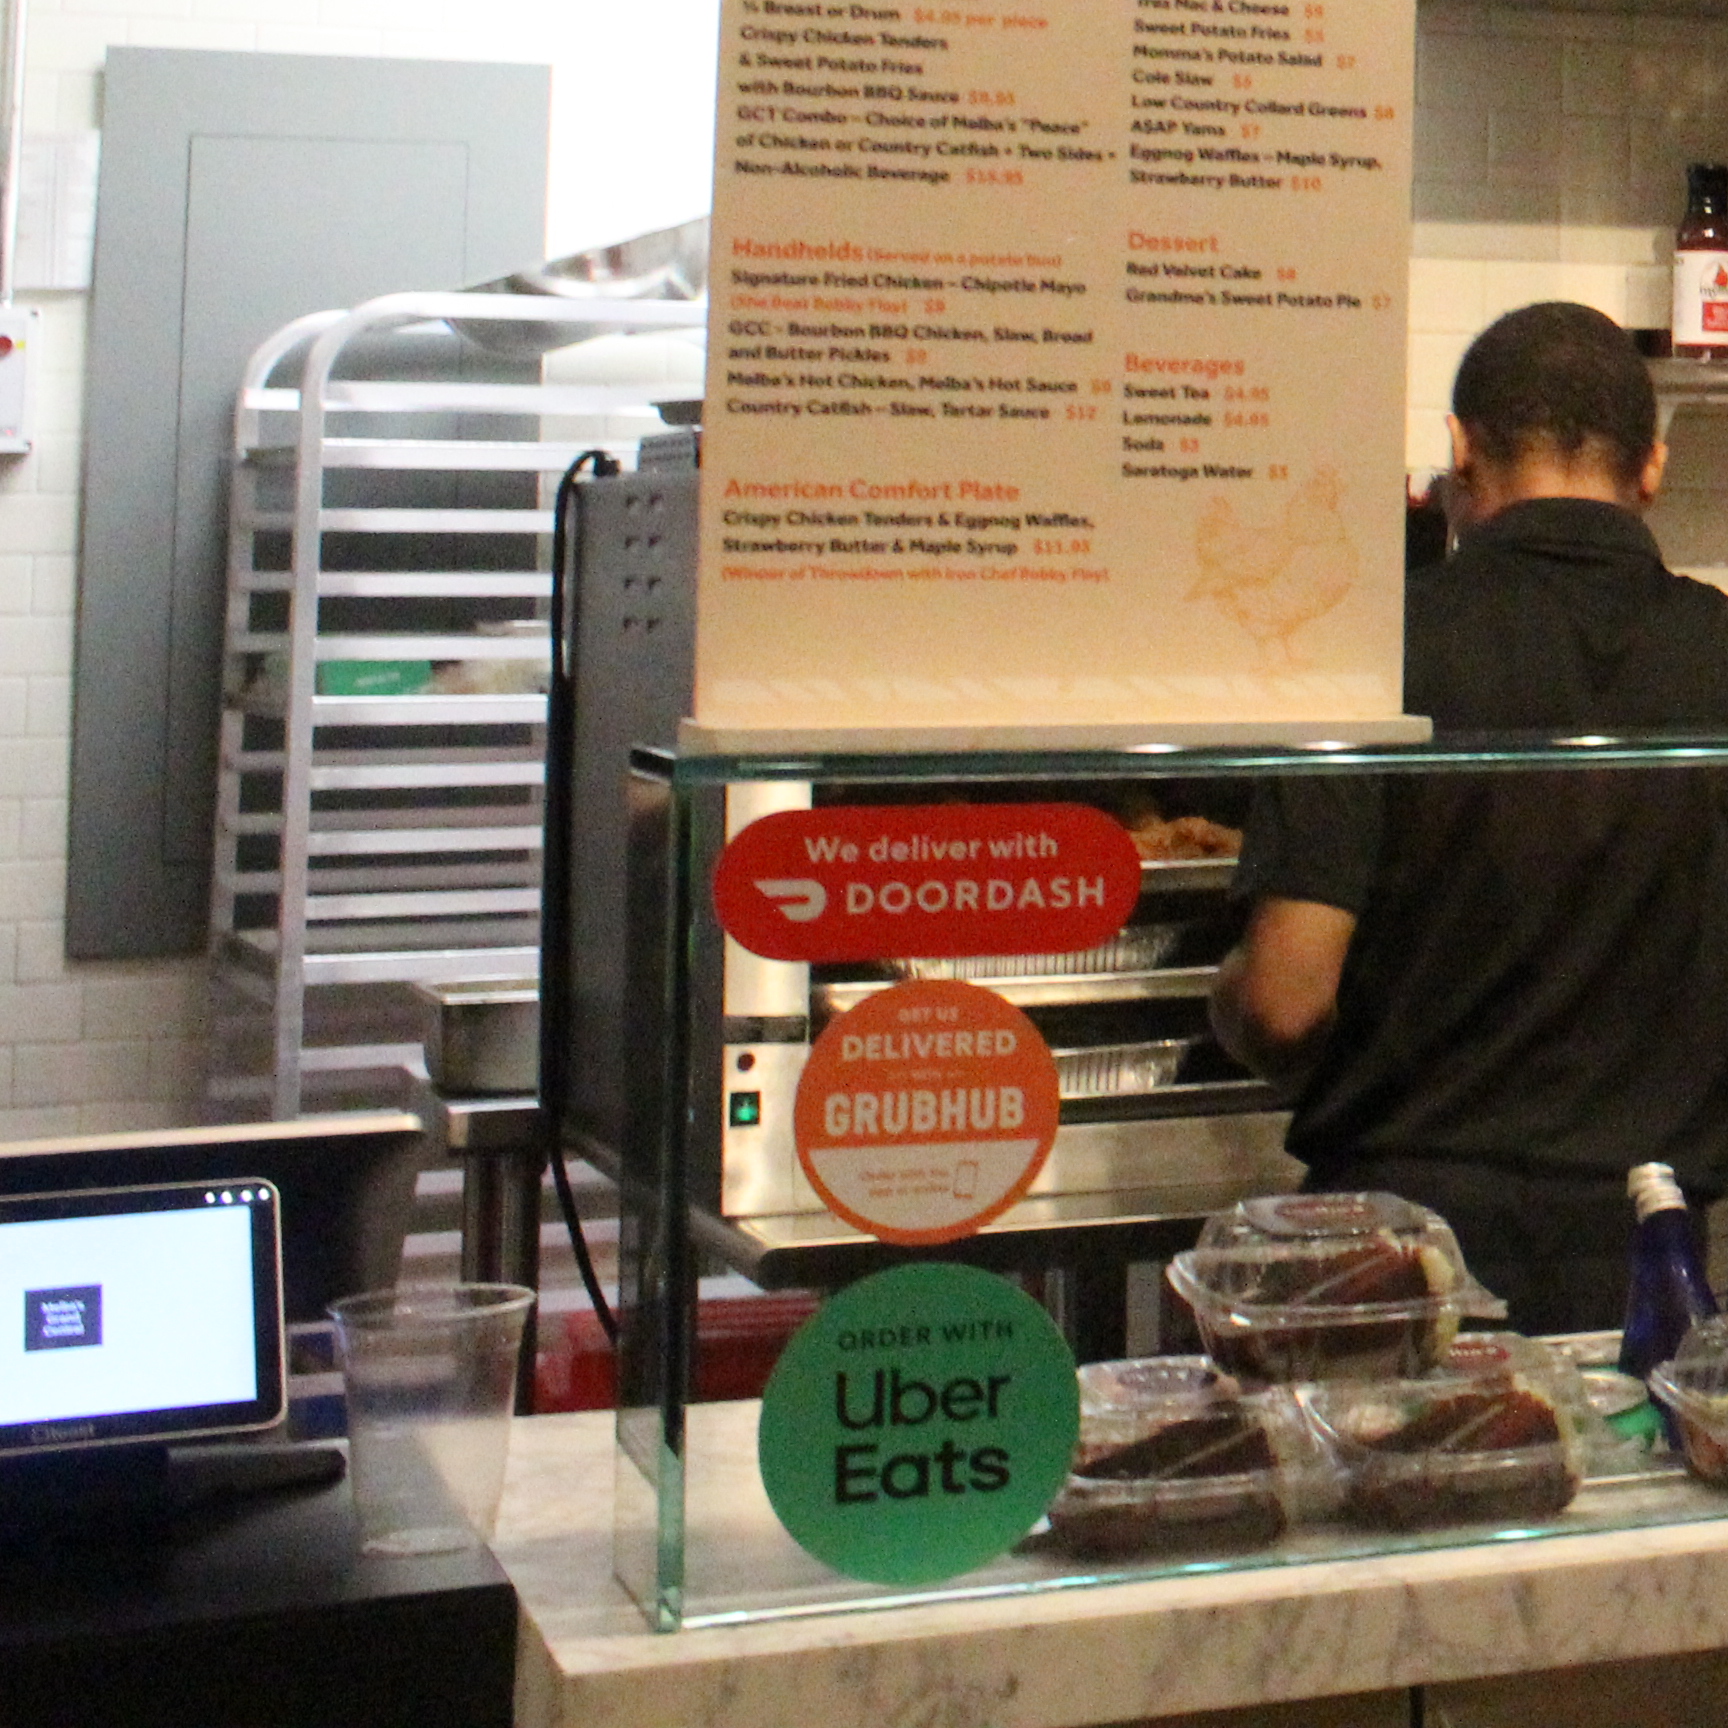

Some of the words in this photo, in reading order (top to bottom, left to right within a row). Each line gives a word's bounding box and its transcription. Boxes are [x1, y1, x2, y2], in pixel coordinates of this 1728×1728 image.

[733, 240, 864, 261] Handhelds
[1129, 231, 1218, 252] Dessert
[730, 269, 821, 289] Signature
[821, 271, 871, 289] Fried
[871, 273, 945, 291] Chicken
[959, 275, 1037, 295] Chipotle
[1038, 278, 1088, 297] Mayo
[727, 345, 763, 361] and
[763, 344, 824, 362] Butter
[827, 346, 891, 363] Pickles
[1125, 353, 1245, 380] Beverages
[1123, 383, 1177, 400] Sweet
[1182, 384, 1211, 401] Tea
[724, 478, 843, 500] American
[848, 478, 952, 501] Comfort
[957, 479, 1021, 502] Plate
[804, 836, 859, 864] We
[868, 835, 981, 863] deliver
[988, 832, 1058, 859] with
[846, 876, 1105, 915] DOORDASH
[842, 1030, 1017, 1061] DELIVERED
[825, 1086, 1024, 1136] GRUBHUB
[836, 1324, 932, 1353] ORDER
[940, 1319, 1015, 1344] WITH
[834, 1366, 1011, 1432] Uber
[834, 1438, 1011, 1505] Eats
